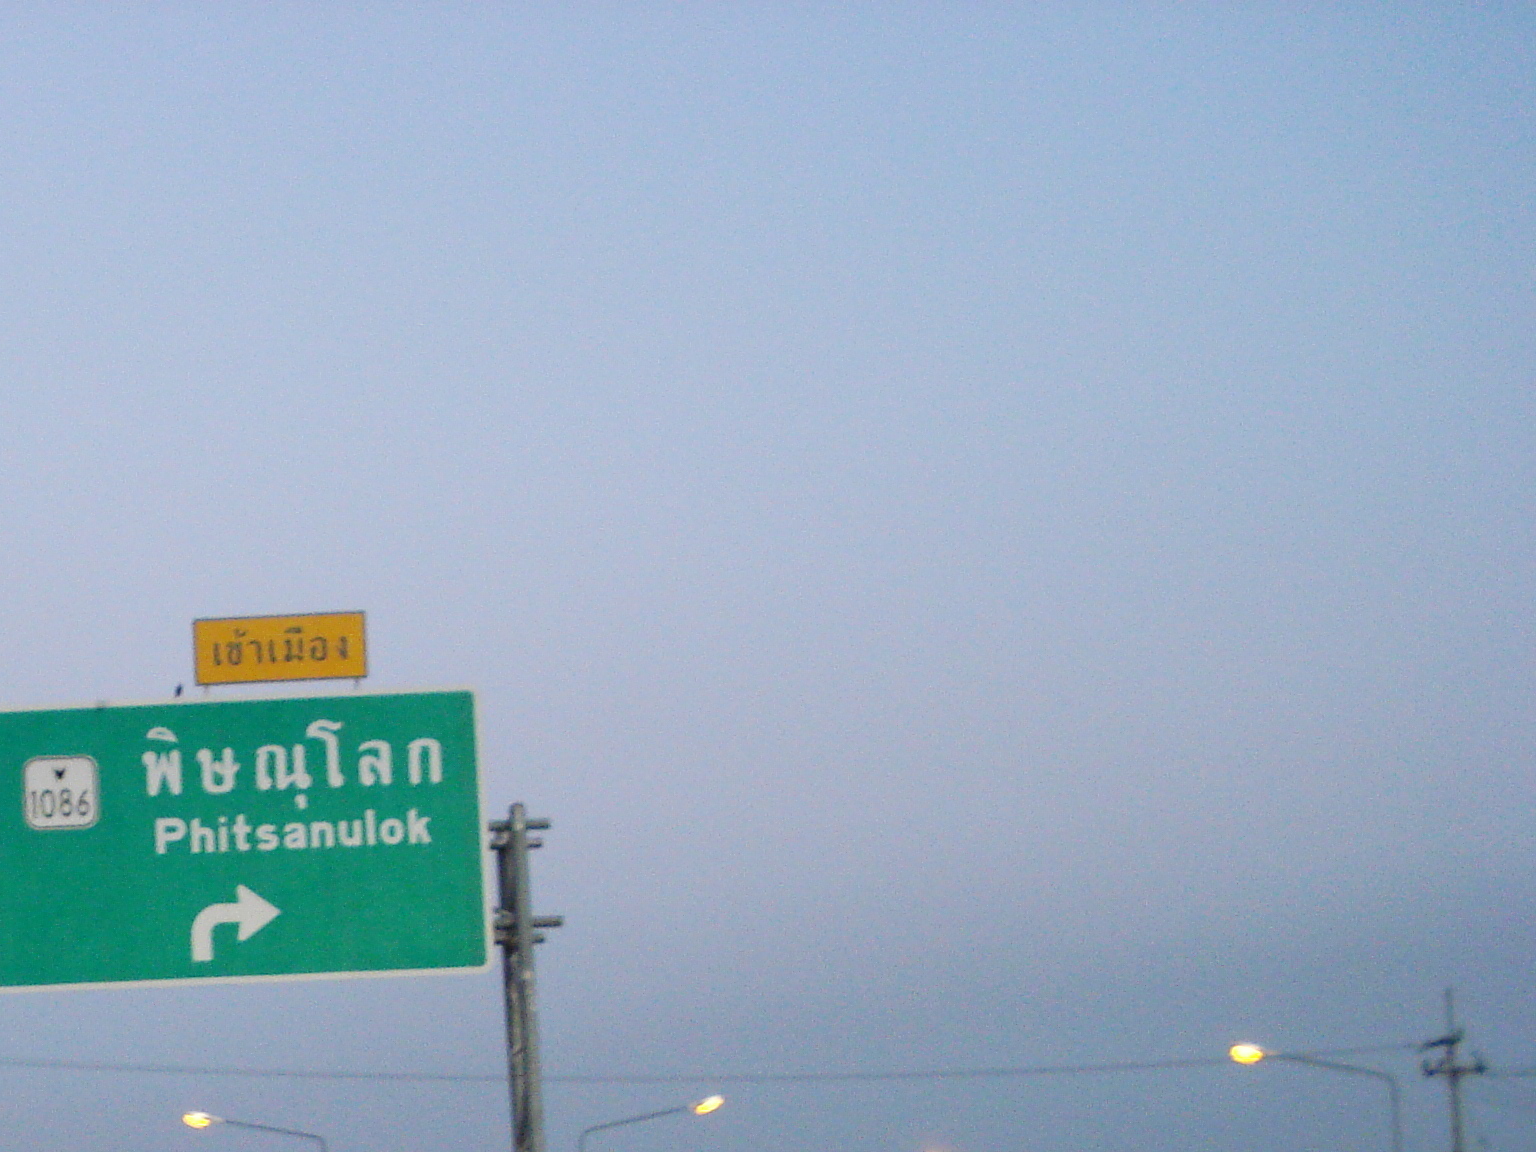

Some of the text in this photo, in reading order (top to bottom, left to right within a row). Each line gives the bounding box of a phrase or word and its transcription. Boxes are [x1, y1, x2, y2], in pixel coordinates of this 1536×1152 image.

[211, 627, 349, 666] เข้าเมือง
[141, 719, 444, 810] พิษณุโลก
[31, 788, 90, 819] 1086
[154, 808, 433, 855] Phitsanulok
